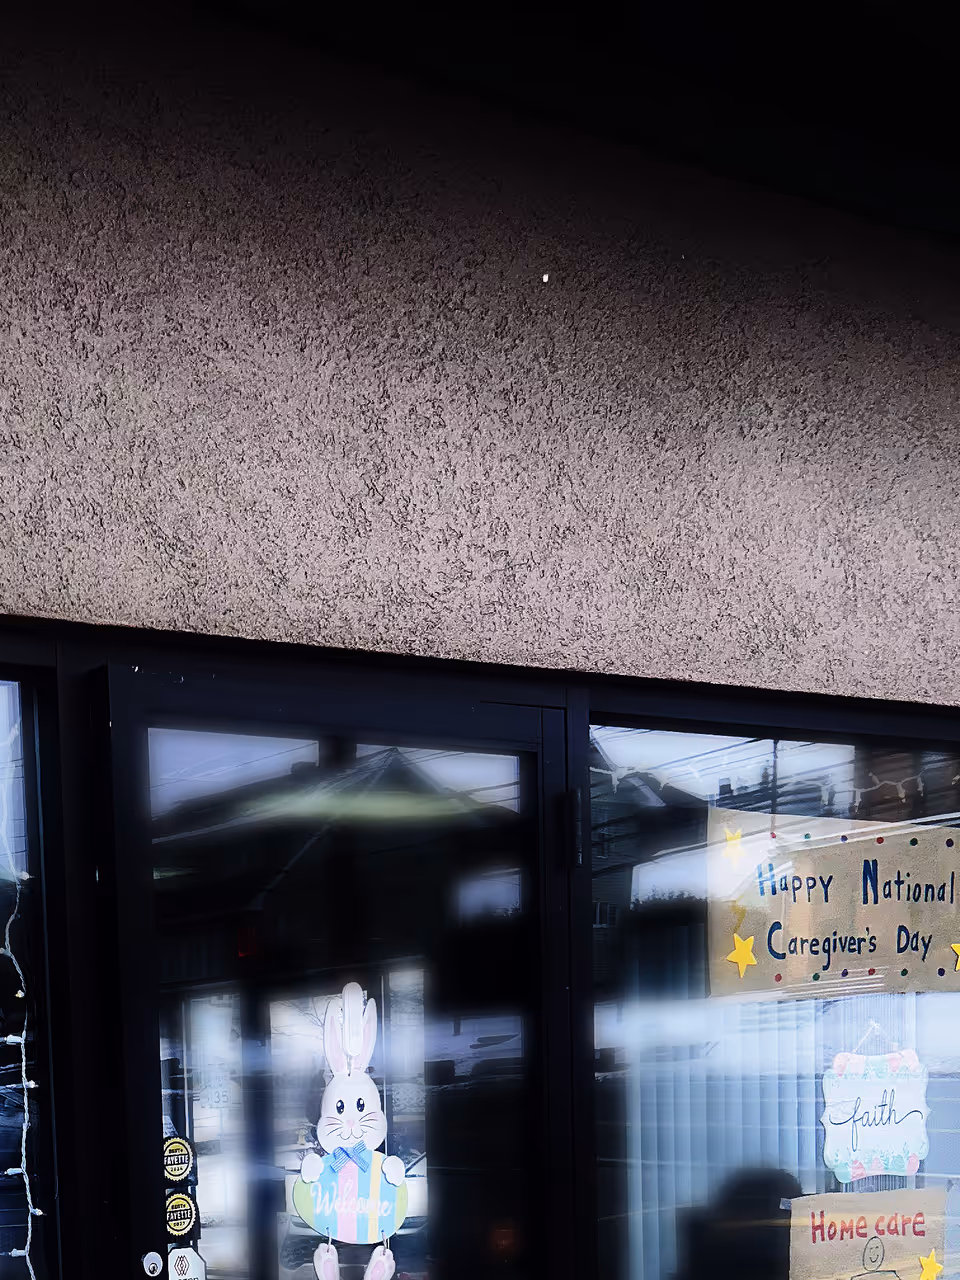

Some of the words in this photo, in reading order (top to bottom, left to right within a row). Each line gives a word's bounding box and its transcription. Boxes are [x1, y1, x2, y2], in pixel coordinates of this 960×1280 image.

[757, 863, 833, 903] Happy
[862, 859, 955, 905] National
[767, 921, 877, 971] Caregiver's
[897, 925, 933, 962] Day
[828, 1088, 924, 1153] faith
[163, 1155, 189, 1166] FAYETTE
[166, 1209, 192, 1221] FAYETTE
[874, 1211, 926, 1237] care
